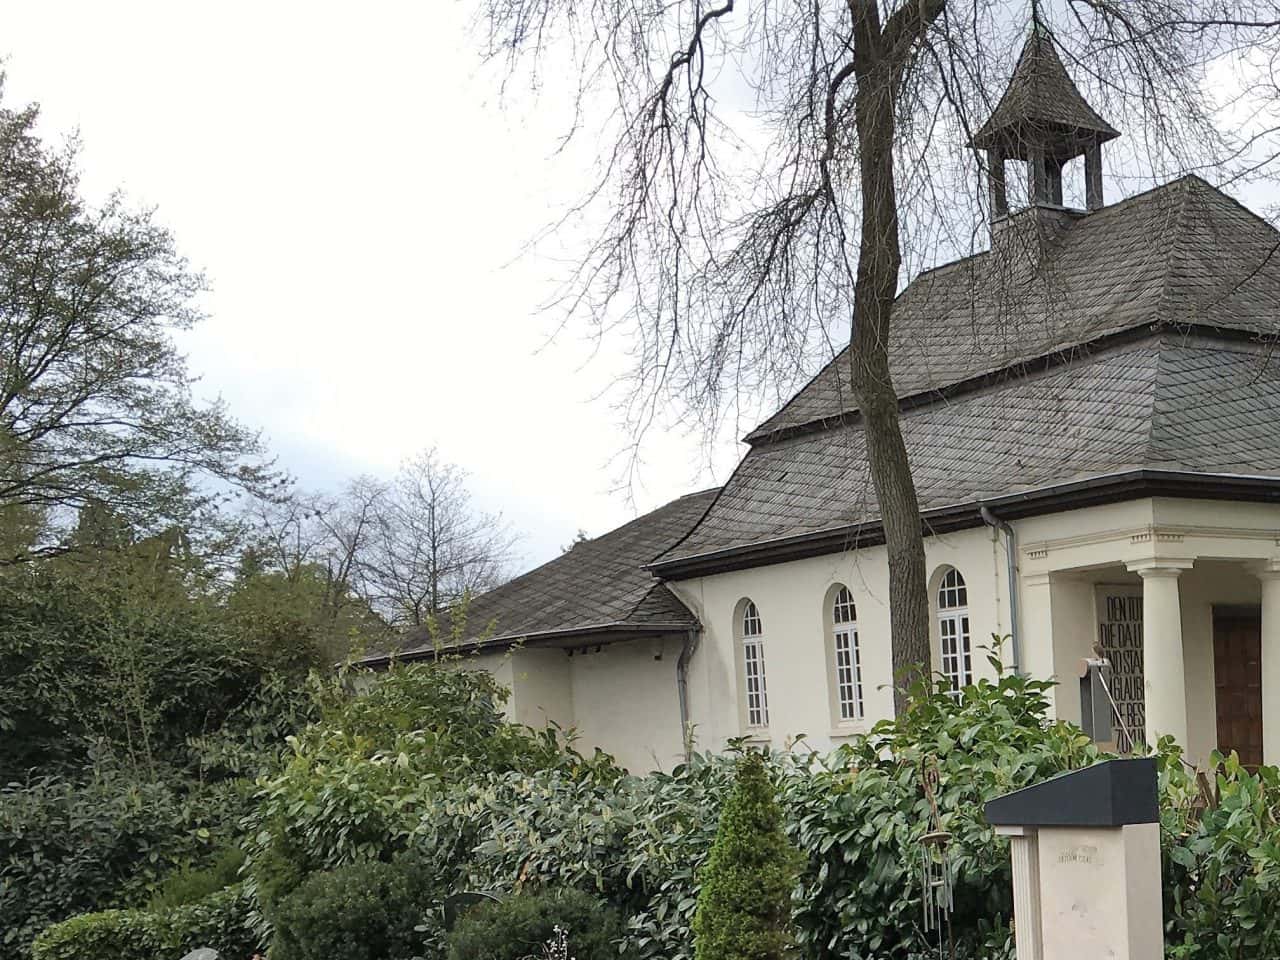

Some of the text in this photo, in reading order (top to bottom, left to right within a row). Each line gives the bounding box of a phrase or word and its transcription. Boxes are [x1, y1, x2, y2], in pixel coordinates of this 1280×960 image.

[1107, 596, 1127, 622] DEN
[1100, 623, 1117, 649] DIE
[1118, 623, 1133, 649] DA
[1105, 650, 1122, 674] ND
[1113, 676, 1144, 702] GLAUB
